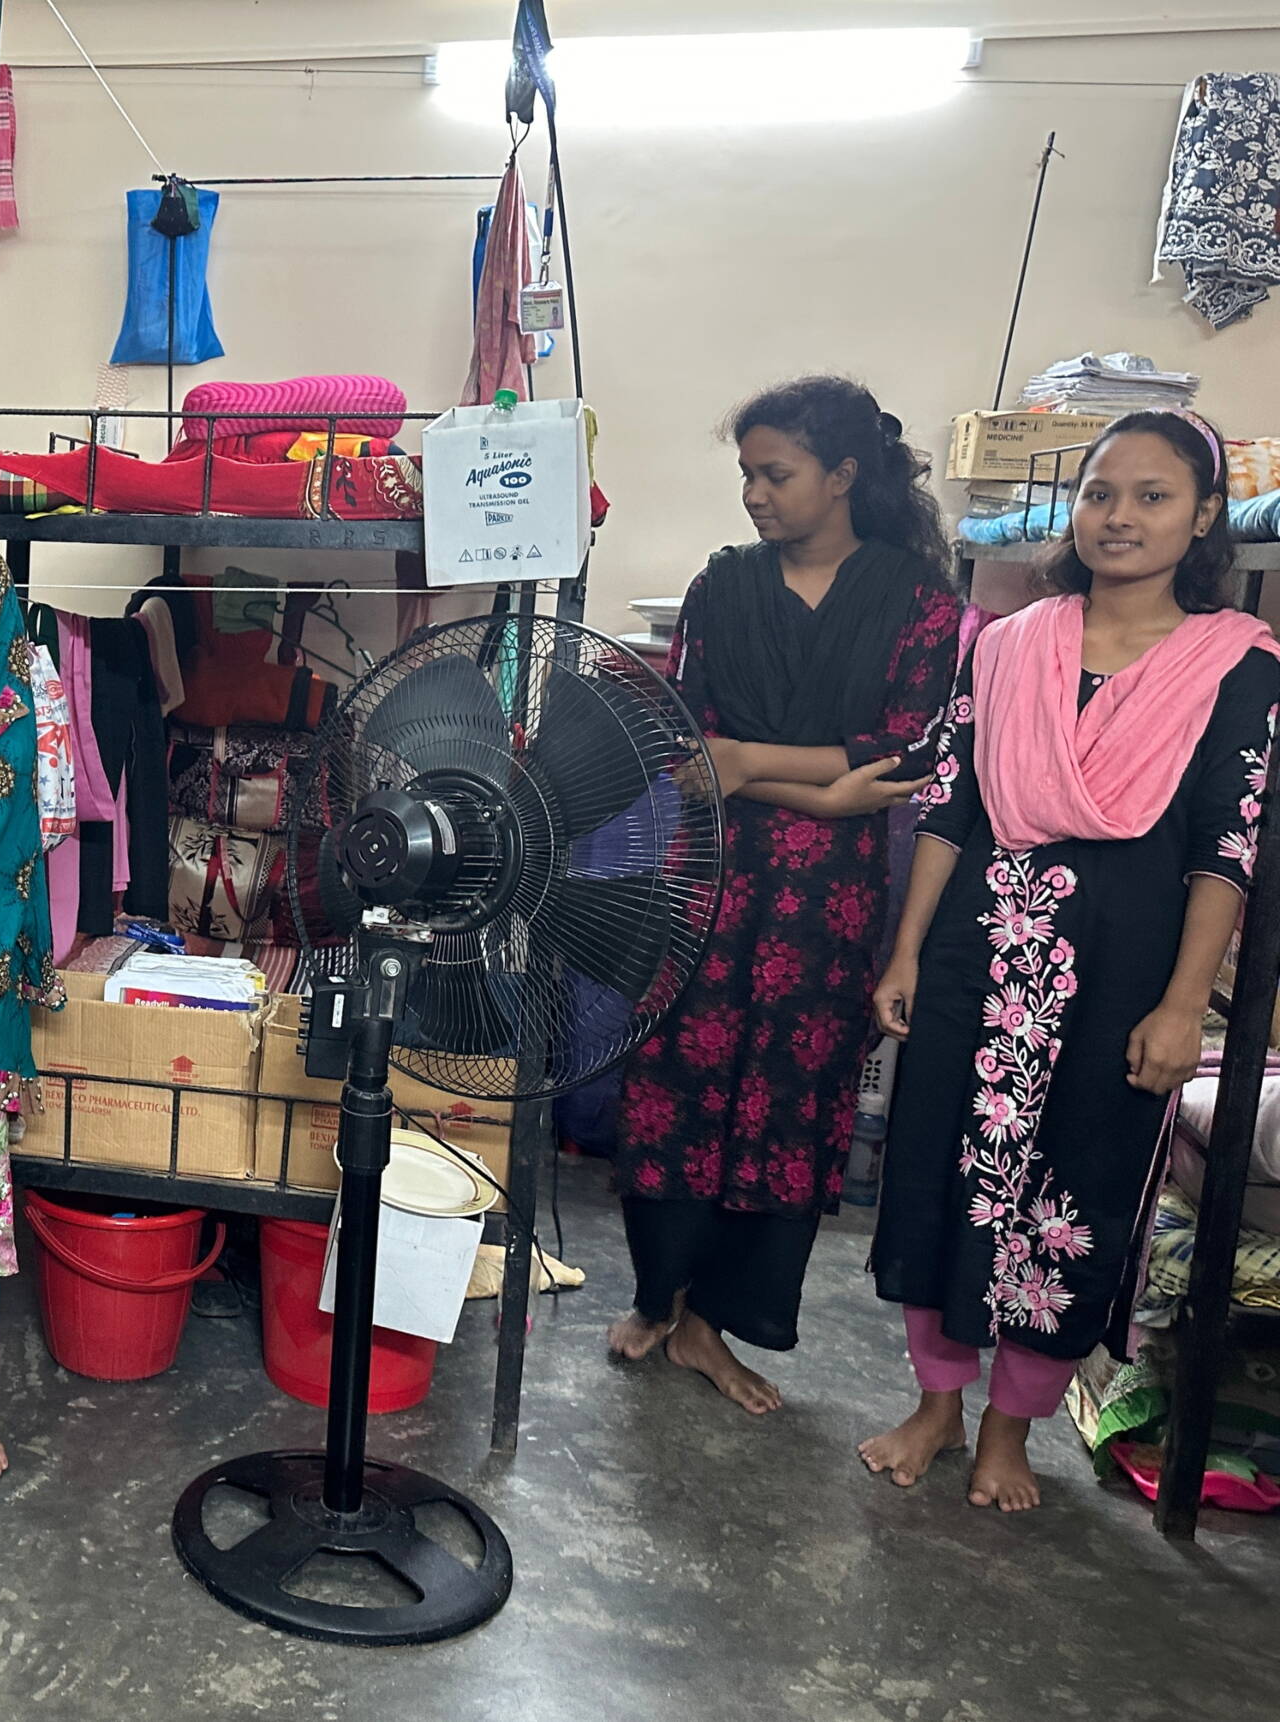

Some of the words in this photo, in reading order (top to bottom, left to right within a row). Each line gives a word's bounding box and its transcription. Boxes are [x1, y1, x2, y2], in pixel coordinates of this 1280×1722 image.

[986, 434, 1024, 442] MEDICINE
[492, 452, 512, 460] Liter
[465, 457, 532, 488] Aquasonic
[503, 476, 527, 485] 100
[479, 491, 519, 500] ULTRASOUND
[469, 499, 516, 508] TRANSMISSION
[45, 1090, 86, 1103] BEXICO
[89, 1095, 173, 1115] PHARMACEUTICAL
